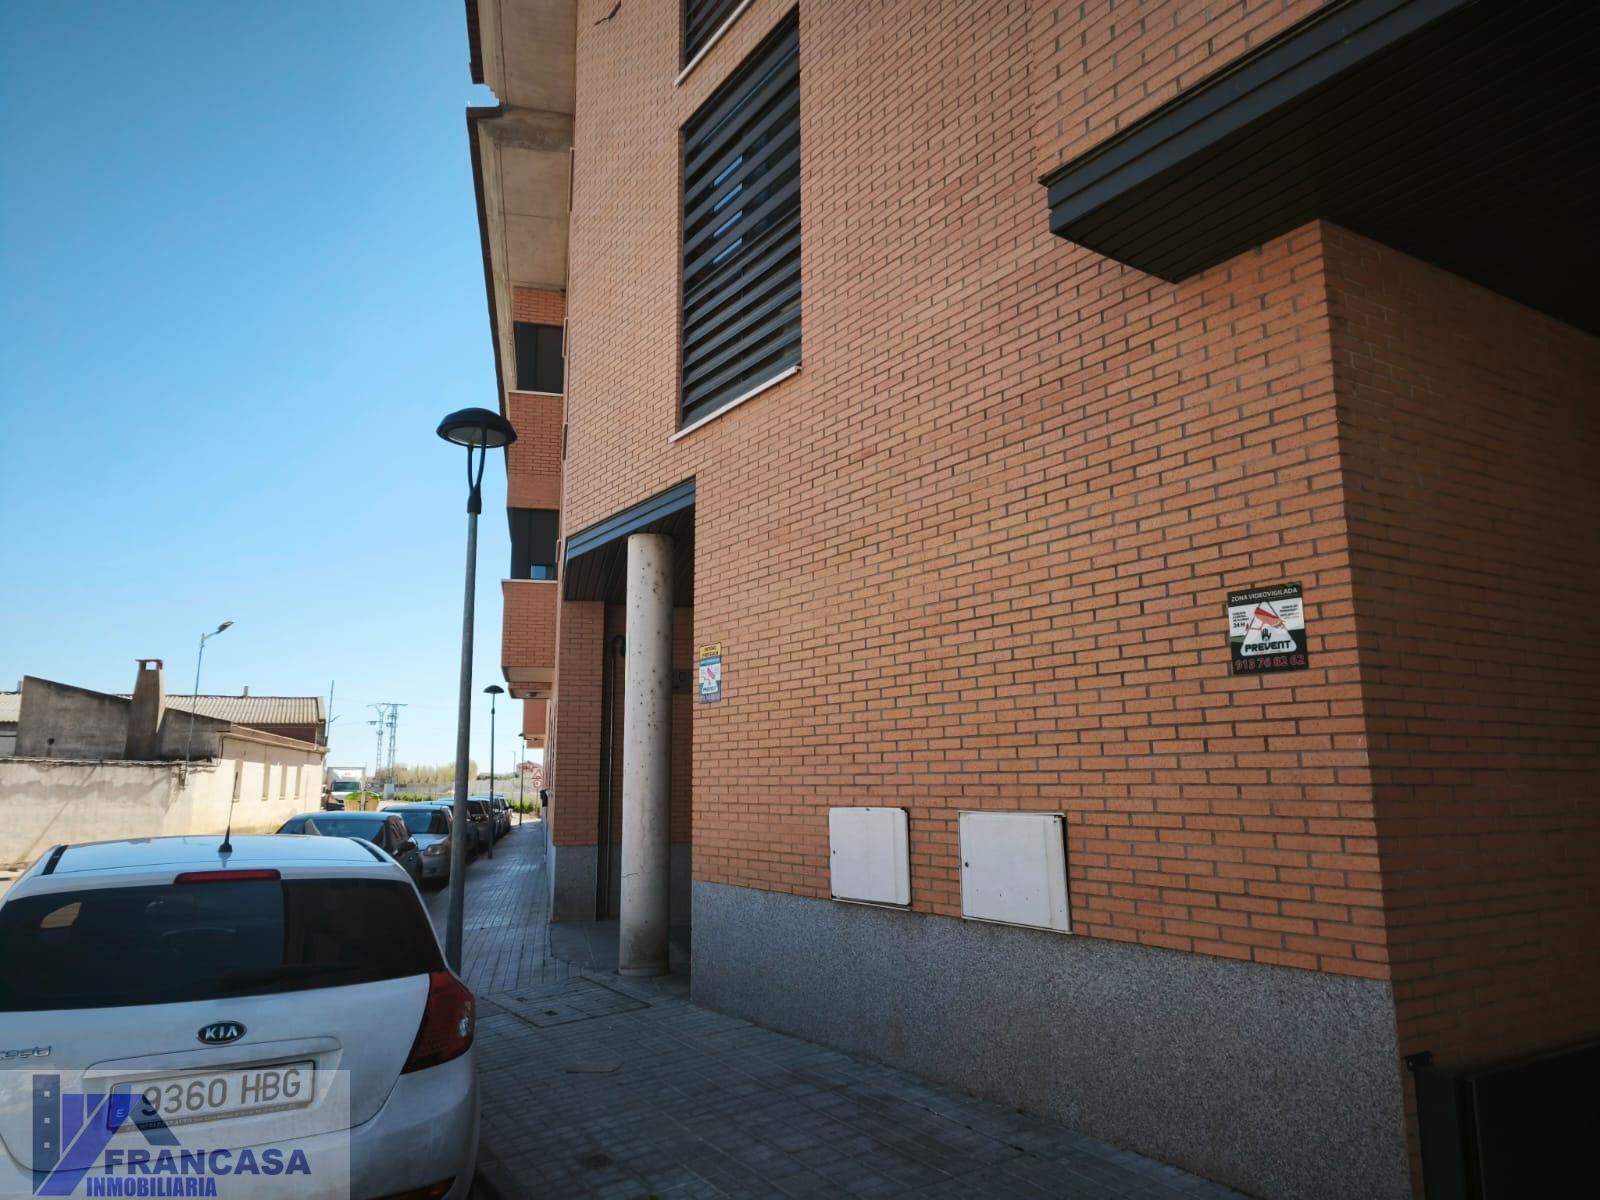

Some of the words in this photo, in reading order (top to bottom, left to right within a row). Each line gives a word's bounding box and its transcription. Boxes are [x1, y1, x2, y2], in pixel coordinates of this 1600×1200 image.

[1231, 594, 1249, 602] ZONA
[1248, 587, 1298, 600] VIDEOVIGILADA
[1244, 640, 1291, 653] PREVENT
[205, 1025, 238, 1040] KIA
[142, 1078, 228, 1116] 9360
[240, 1068, 302, 1105] HBG
